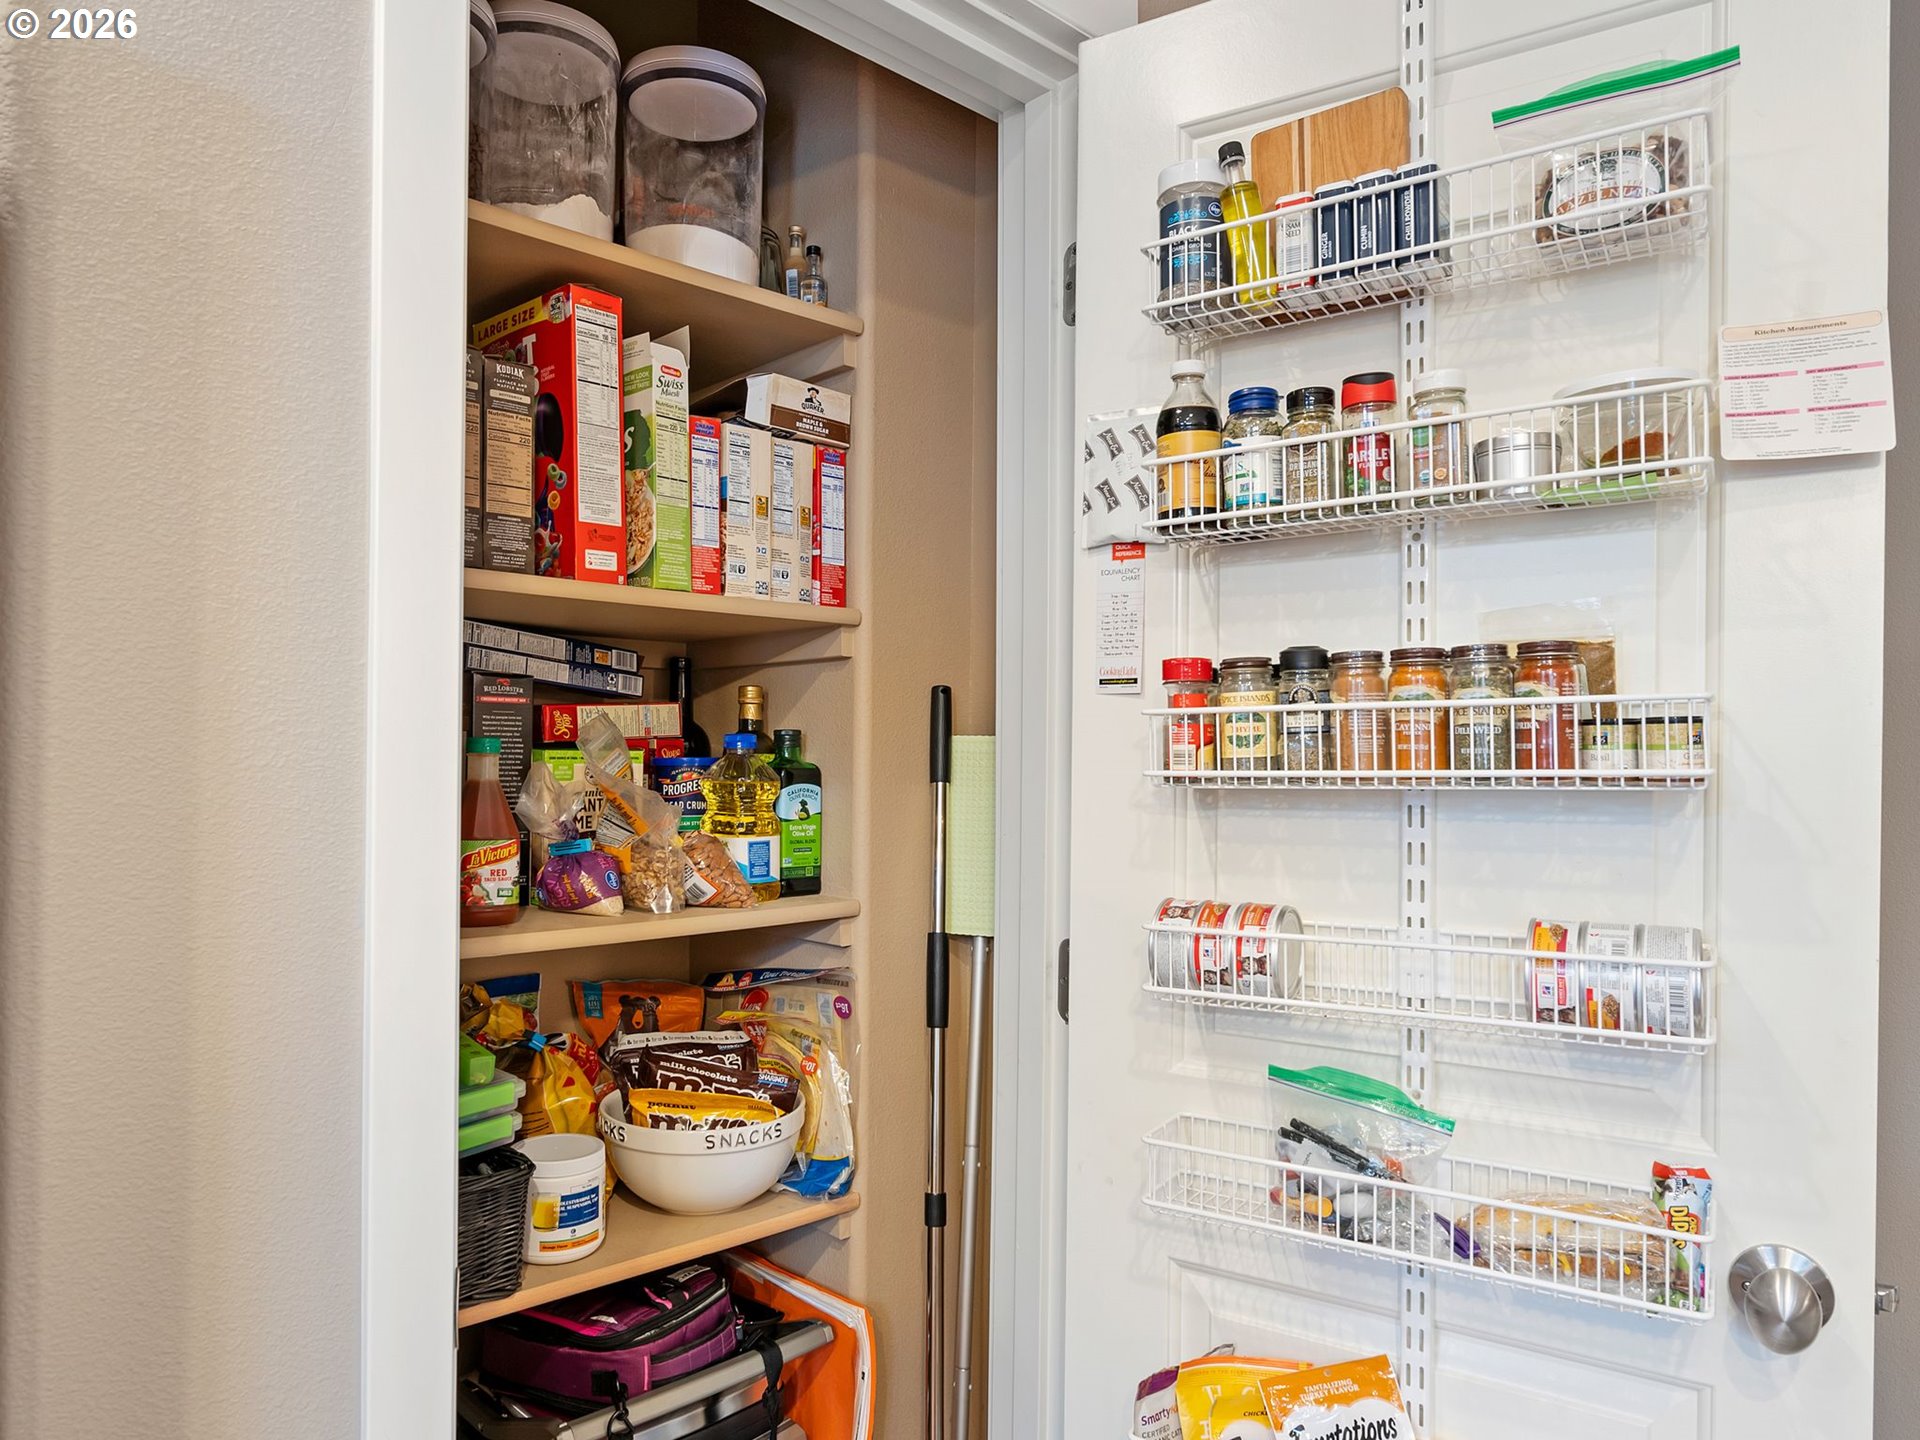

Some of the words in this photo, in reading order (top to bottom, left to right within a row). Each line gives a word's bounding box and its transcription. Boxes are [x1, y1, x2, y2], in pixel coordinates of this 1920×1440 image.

[1169, 225, 1198, 238] BLACK
[1360, 224, 1368, 250] CUMIN
[478, 319, 509, 342] LARGE
[511, 307, 535, 327] SIZE
[1754, 326, 1787, 336] Kitchen
[1787, 320, 1848, 333] Measurements
[496, 363, 525, 379] KODIAK
[636, 371, 649, 379] LOOK
[493, 377, 517, 386] FLAPJACK
[656, 375, 685, 391] Swiss
[801, 402, 825, 414] QUAKER
[488, 410, 515, 419] Nutrition
[515, 415, 531, 423] Facts
[802, 417, 818, 425] MAPLE
[796, 421, 812, 431] BROWN
[812, 425, 829, 434] SUGAR
[488, 432, 511, 441] Calories
[519, 436, 531, 445] 220
[1293, 469, 1318, 479] LEVES
[1101, 568, 1141, 577] EQUIVALENCY
[497, 684, 524, 693] LOBSTER
[1222, 694, 1237, 703] SPICE
[1240, 693, 1271, 702] ISLANDS
[1474, 725, 1502, 735] WED
[671, 767, 691, 775] Quality
[787, 787, 819, 797] CALIFORNIA
[788, 793, 801, 802] OLIVE
[801, 793, 818, 801] RANCH
[466, 853, 481, 869] La
[479, 843, 518, 865] Victoria
[490, 869, 508, 877] RED
[760, 971, 779, 980] Flour
[660, 1060, 687, 1072] milk
[686, 1064, 738, 1083] chocolate
[758, 1073, 785, 1084] SHARING
[647, 1100, 697, 1110] peanut
[705, 1123, 782, 1150] SNACKS
[1304, 1378, 1353, 1393] TANTALIZING
[1300, 1389, 1329, 1402] TURKEY
[1330, 1384, 1360, 1396] FLAVOR
[1141, 1424, 1170, 1439] CERTIFIED
